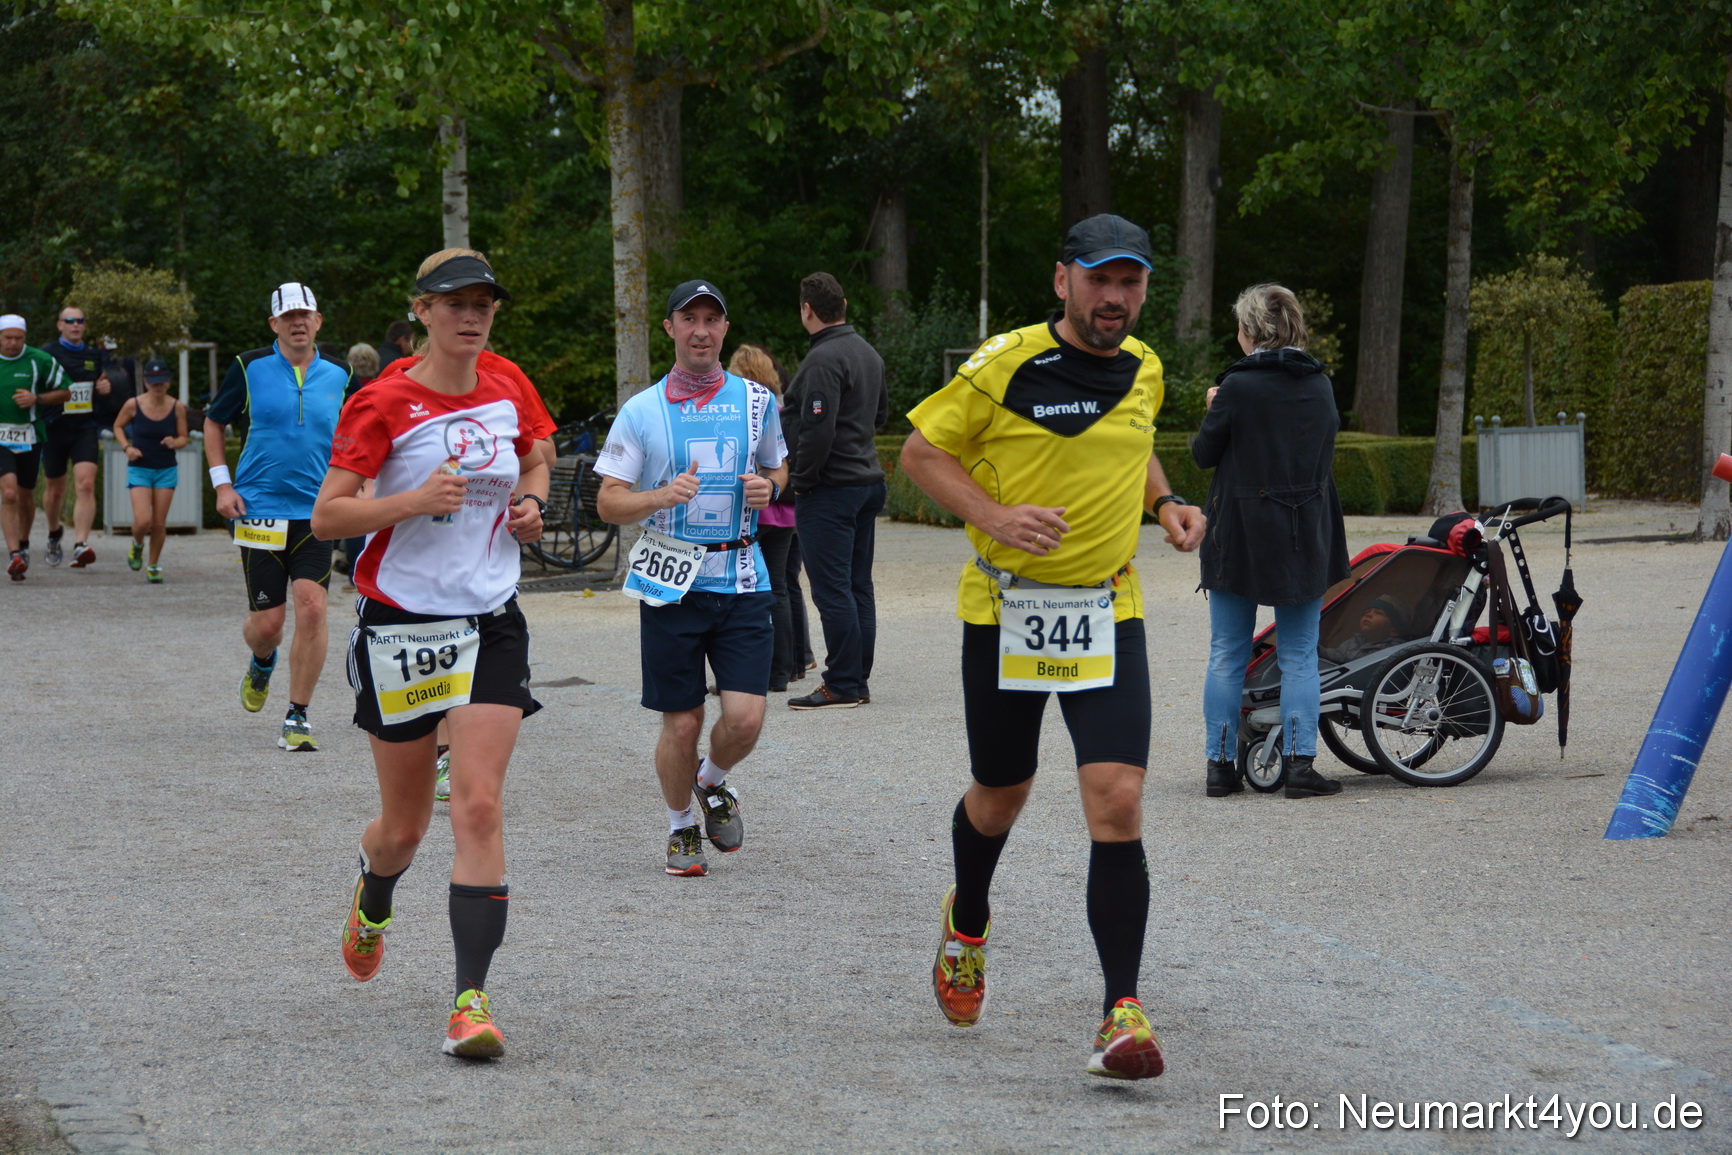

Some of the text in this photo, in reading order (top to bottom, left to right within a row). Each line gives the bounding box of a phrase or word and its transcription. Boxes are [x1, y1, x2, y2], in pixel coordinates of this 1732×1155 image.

[409, 410, 430, 419] erima
[680, 403, 740, 415] VIERTL
[1032, 401, 1101, 419] Bernd W.
[680, 413, 742, 424] DESIGN GmbH
[751, 396, 761, 442] VIERTL
[0, 430, 27, 442] 2421
[488, 477, 514, 489] HERZ
[243, 530, 272, 542] Andreas
[686, 527, 730, 537] raumbox
[658, 540, 692, 557] Neumarkt
[632, 547, 693, 586] 2668
[1002, 599, 1094, 610] PARTL Neumarkt
[370, 630, 461, 646] PARTL Neumarkt
[1024, 614, 1093, 652] 344
[392, 643, 459, 683] 193
[1036, 661, 1079, 678] Bernd
[405, 681, 451, 706] Claudia
